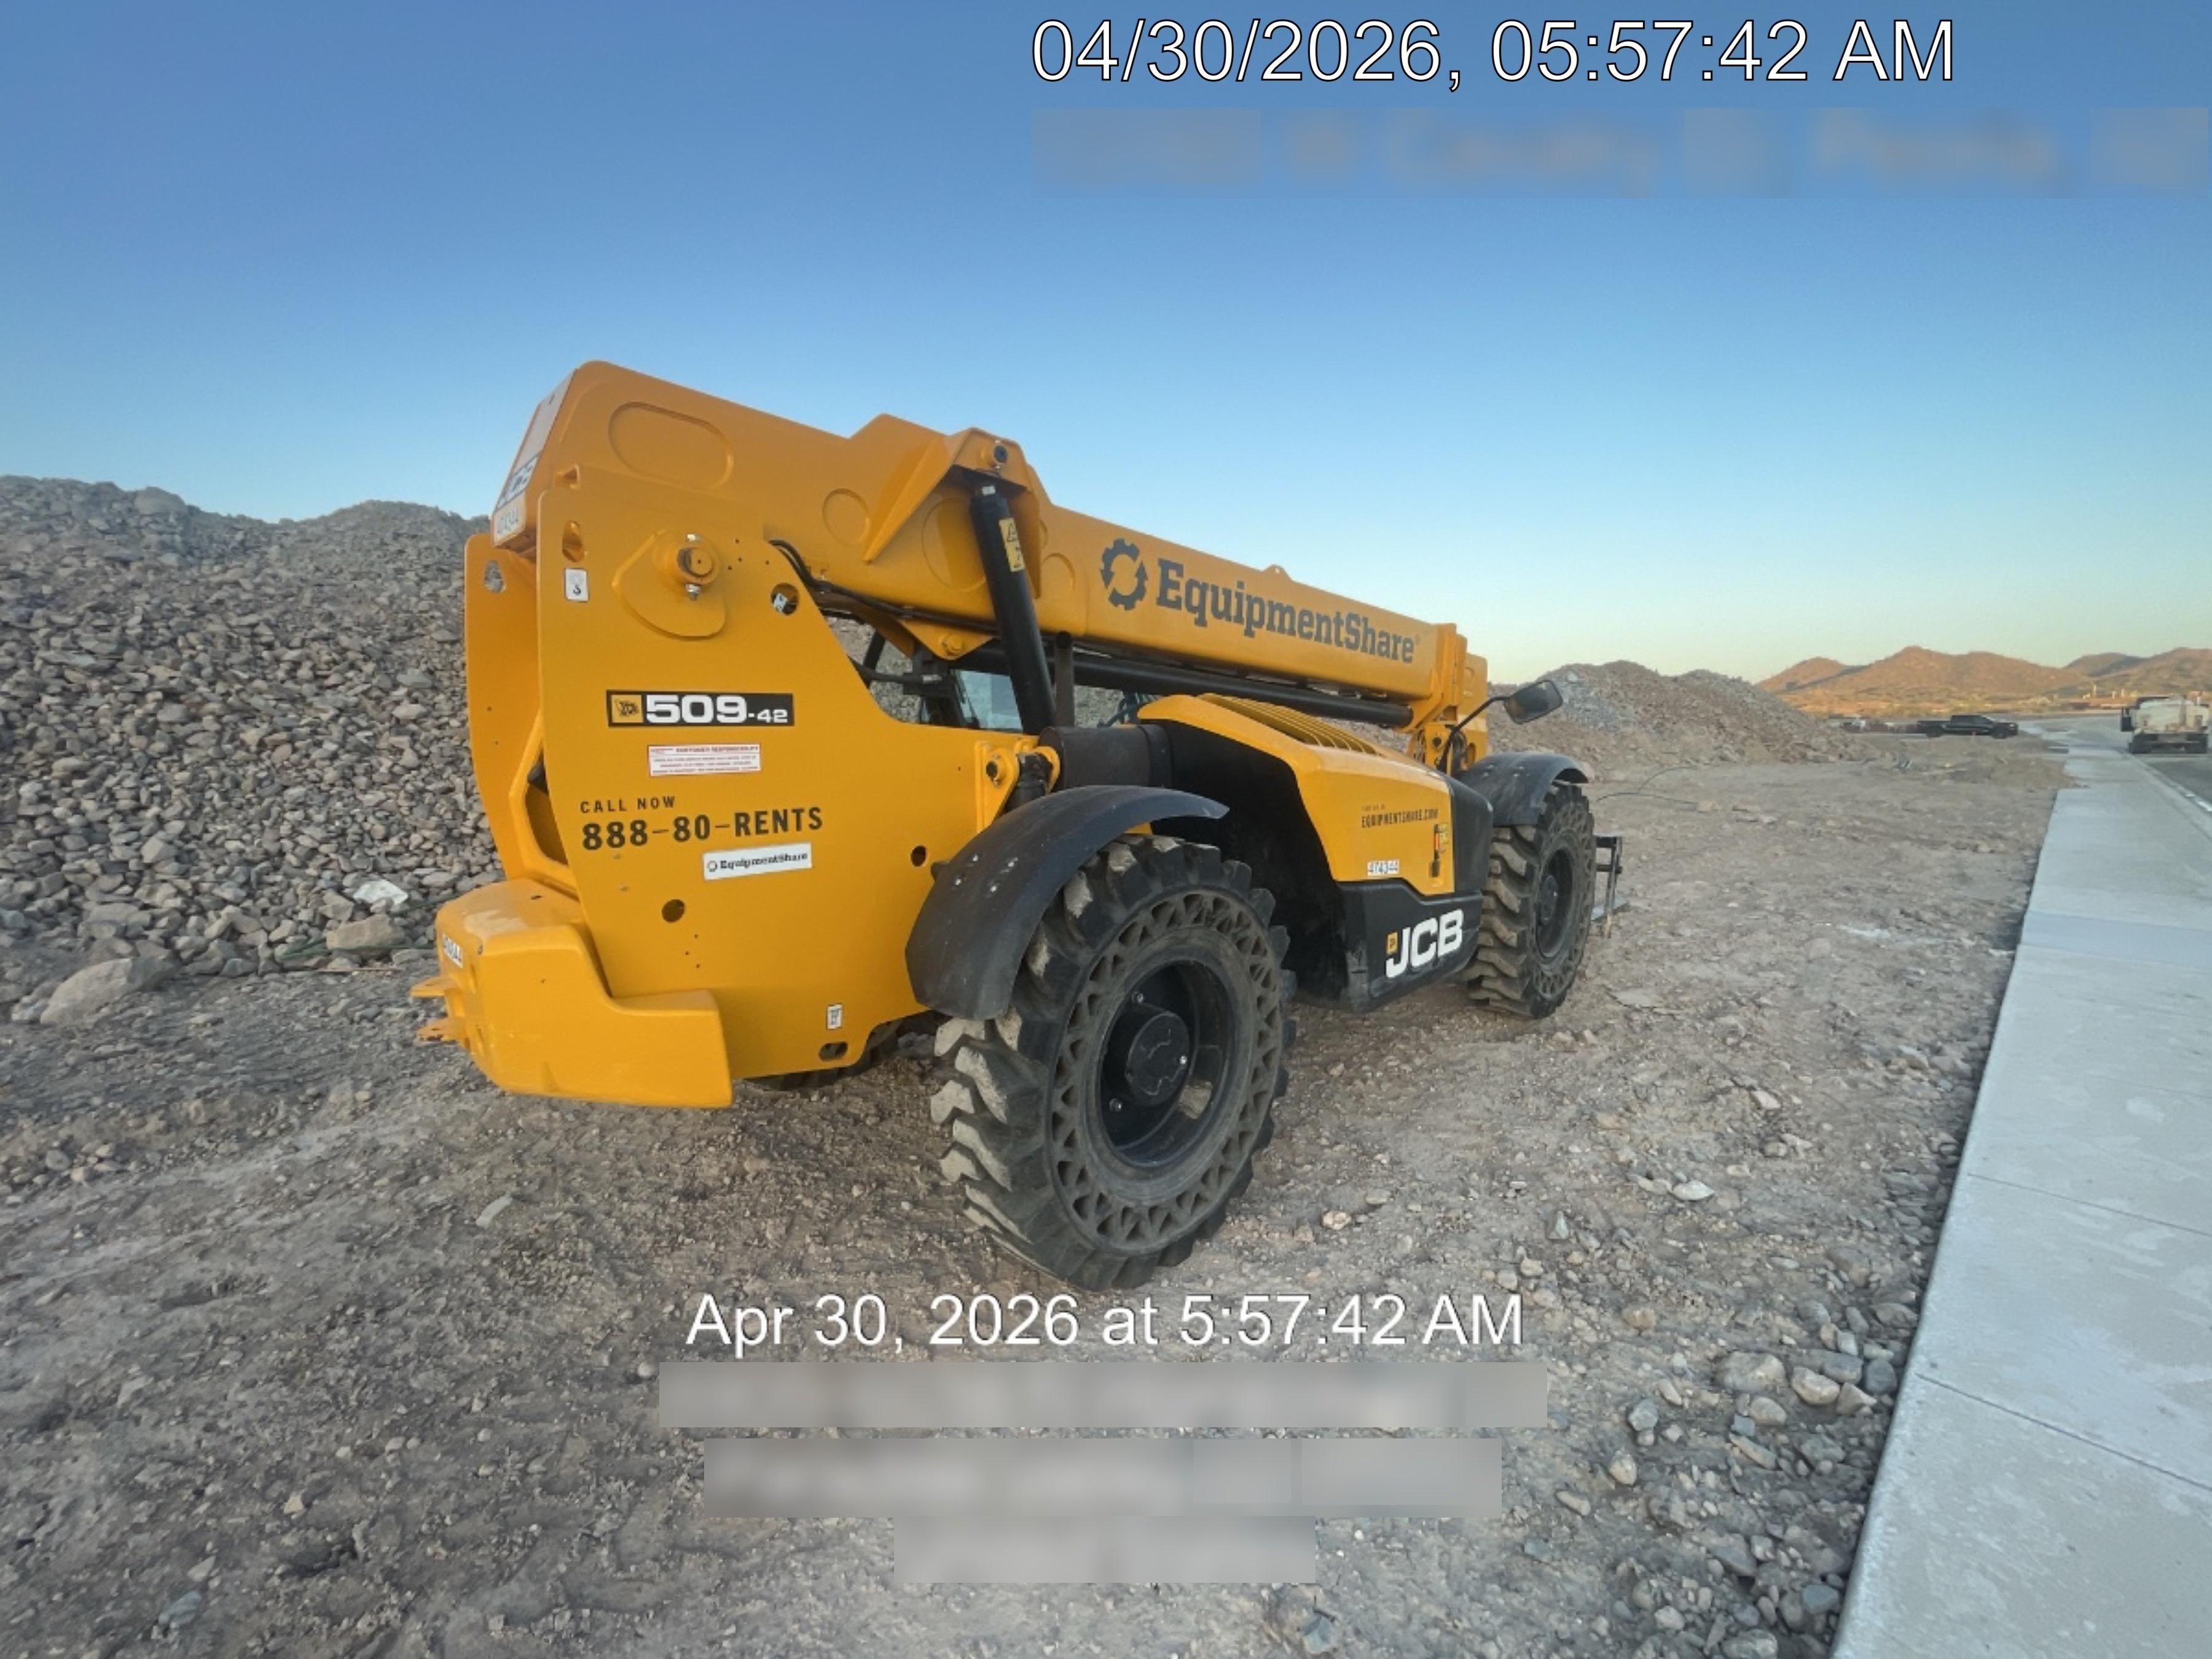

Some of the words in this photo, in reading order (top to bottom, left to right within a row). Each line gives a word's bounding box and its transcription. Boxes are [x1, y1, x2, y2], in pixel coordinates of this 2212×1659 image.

[1156, 558, 1414, 664] EquipmentShare
[646, 694, 788, 724] 509-42
[580, 799, 627, 814] CALL
[637, 796, 676, 810] NOW
[582, 806, 823, 851] 888-80-RENTS
[720, 852, 808, 870] EquipmentShare
[1386, 908, 1464, 978] JCB
